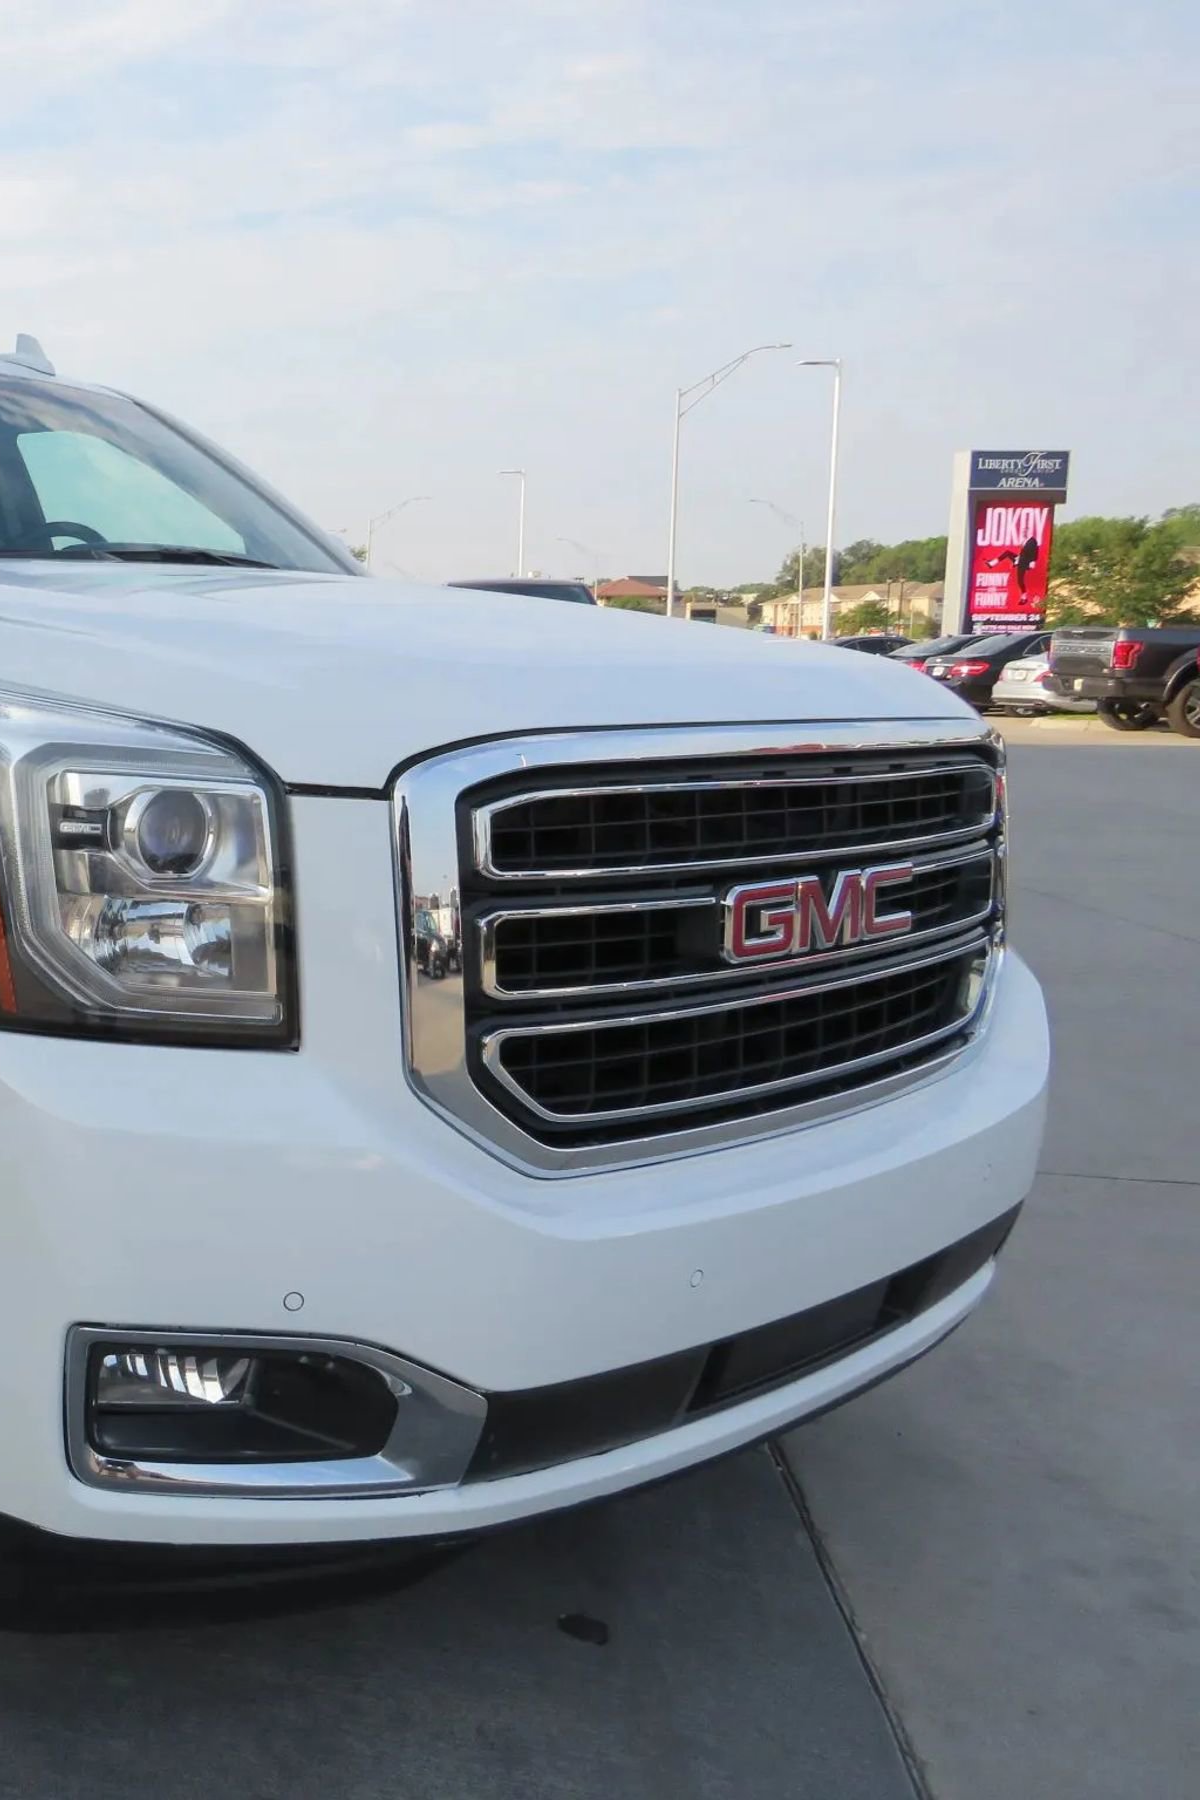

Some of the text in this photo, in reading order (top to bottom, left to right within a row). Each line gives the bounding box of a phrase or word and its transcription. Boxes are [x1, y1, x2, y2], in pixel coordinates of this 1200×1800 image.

[978, 452, 1062, 476] LIBERTY FIRST
[996, 477, 1040, 488] ARENA
[975, 572, 1010, 587] FUNNY
[974, 591, 1008, 606] FUNNY
[972, 613, 1027, 621] SEPTEMBER
[723, 861, 913, 965] GMC
